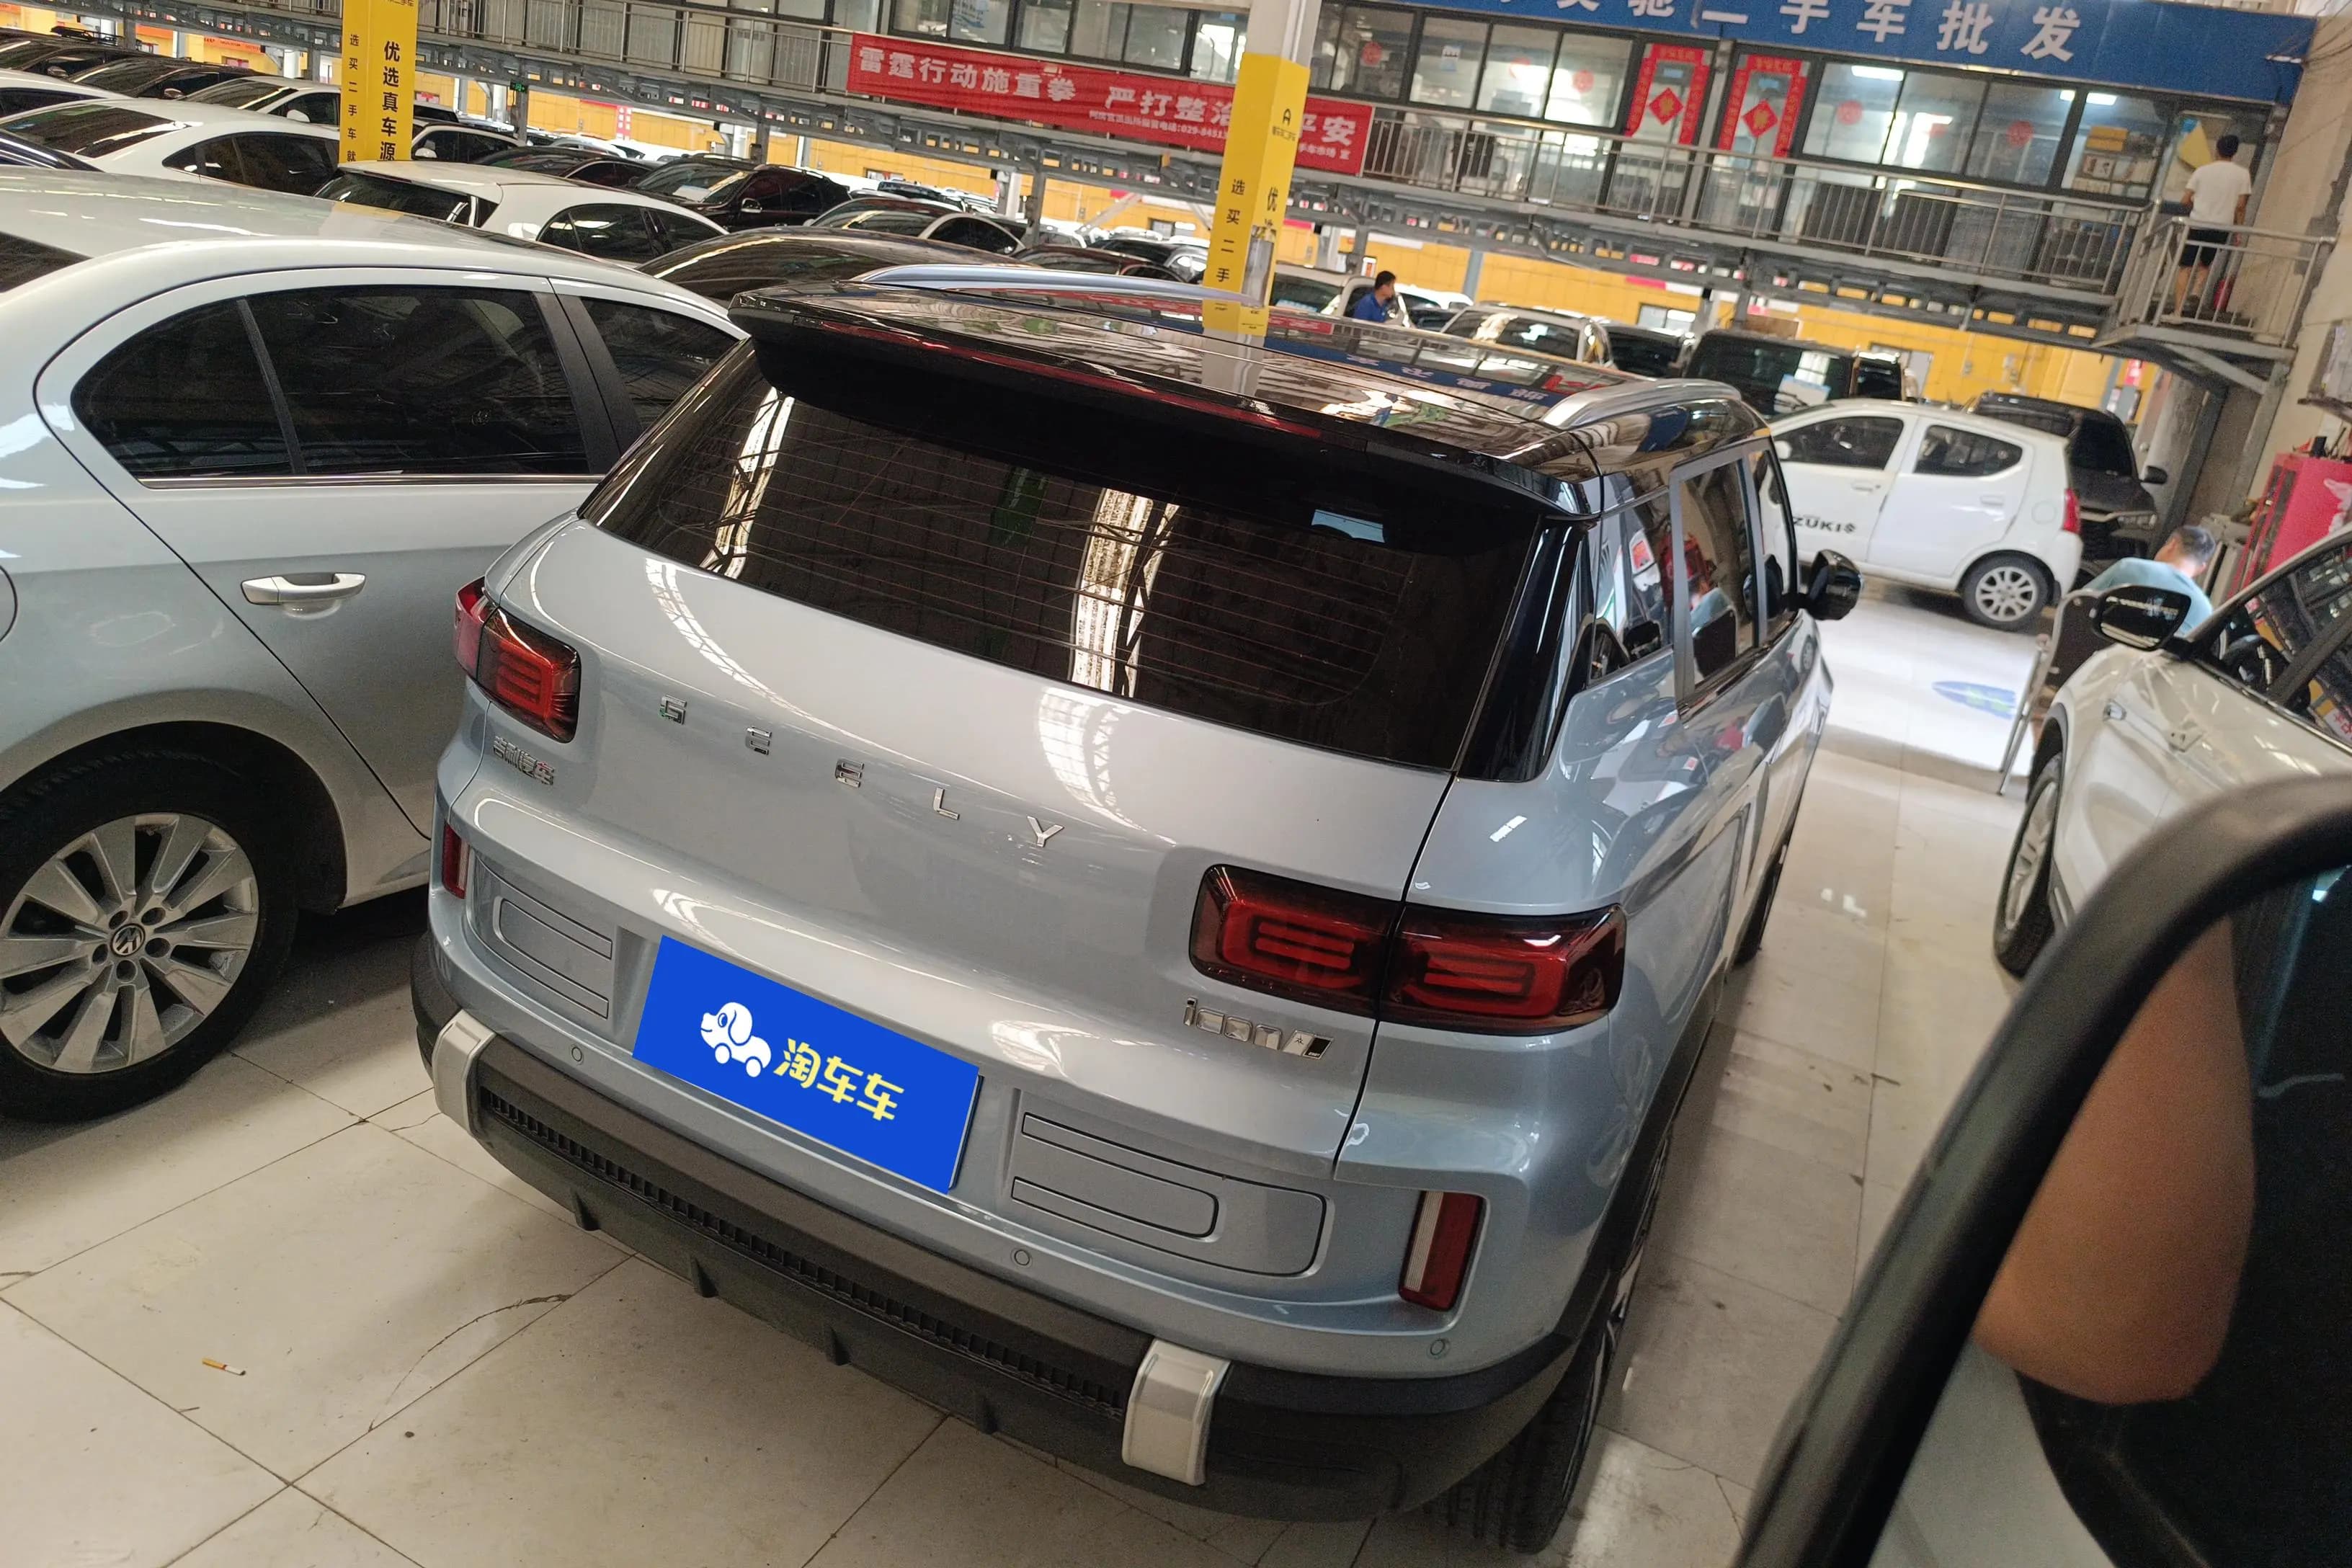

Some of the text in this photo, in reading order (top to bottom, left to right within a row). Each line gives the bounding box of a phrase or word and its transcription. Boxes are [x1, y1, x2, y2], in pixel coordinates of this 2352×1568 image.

[1557, 0, 2081, 63] 手车批发
[347, 34, 360, 162] 选买二手车就
[380, 40, 401, 161] 优选真车源
[859, 46, 1077, 102] 雷霆行动施重拳
[1104, 86, 1356, 146] 严打整治安
[1216, 178, 1245, 282] 选买二手
[493, 736, 554, 785] 吉利汽车
[659, 694, 1064, 848] GEELY
